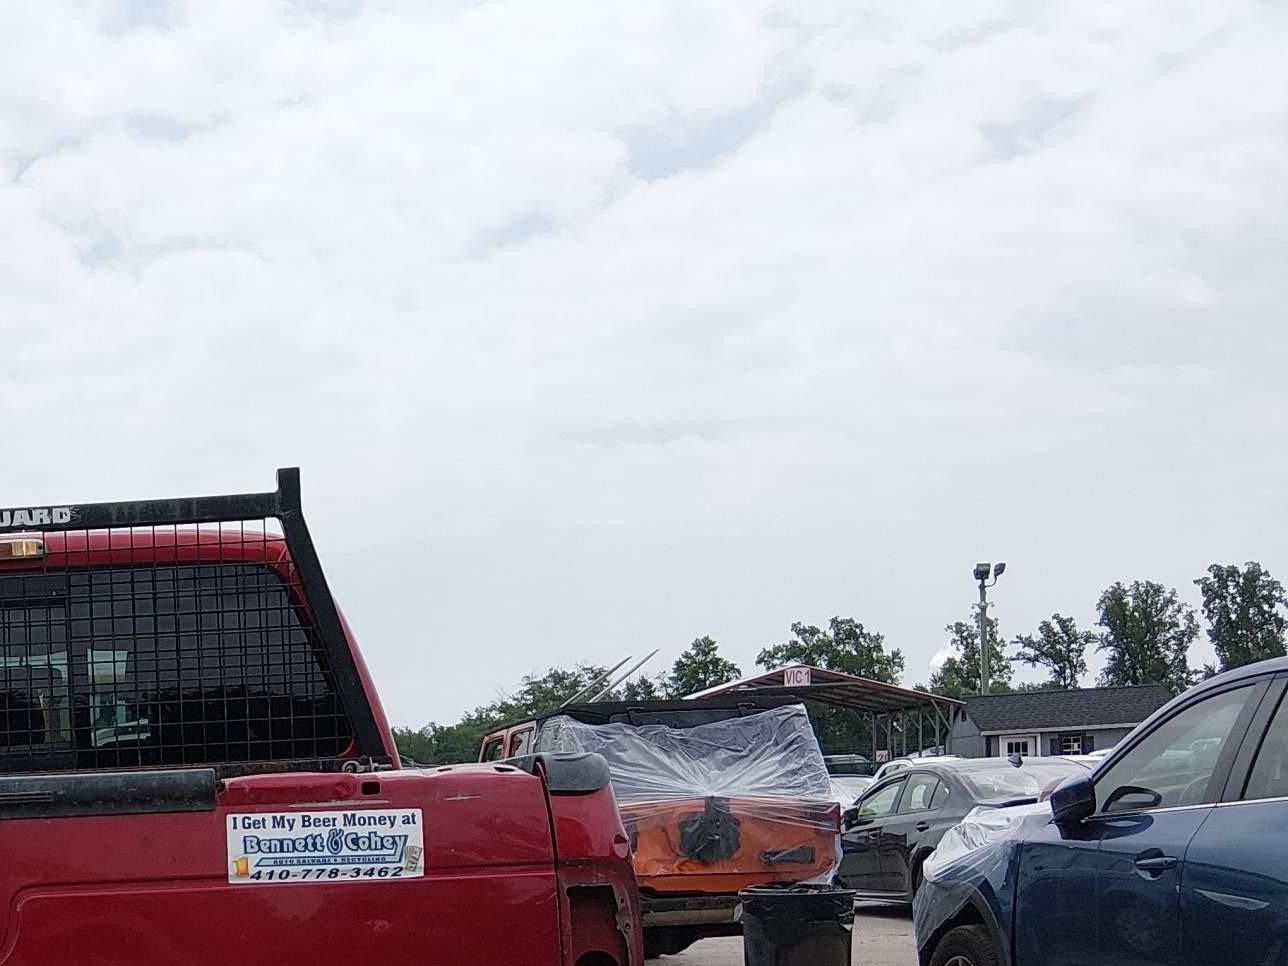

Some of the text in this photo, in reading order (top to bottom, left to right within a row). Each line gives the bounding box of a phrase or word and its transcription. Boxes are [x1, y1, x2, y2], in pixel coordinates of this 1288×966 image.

[785, 670, 802, 685] VIC
[232, 813, 416, 831] I Get My Beer Money at
[243, 828, 408, 855] Bennett & Cohey
[249, 866, 403, 881] 410-778-3462
